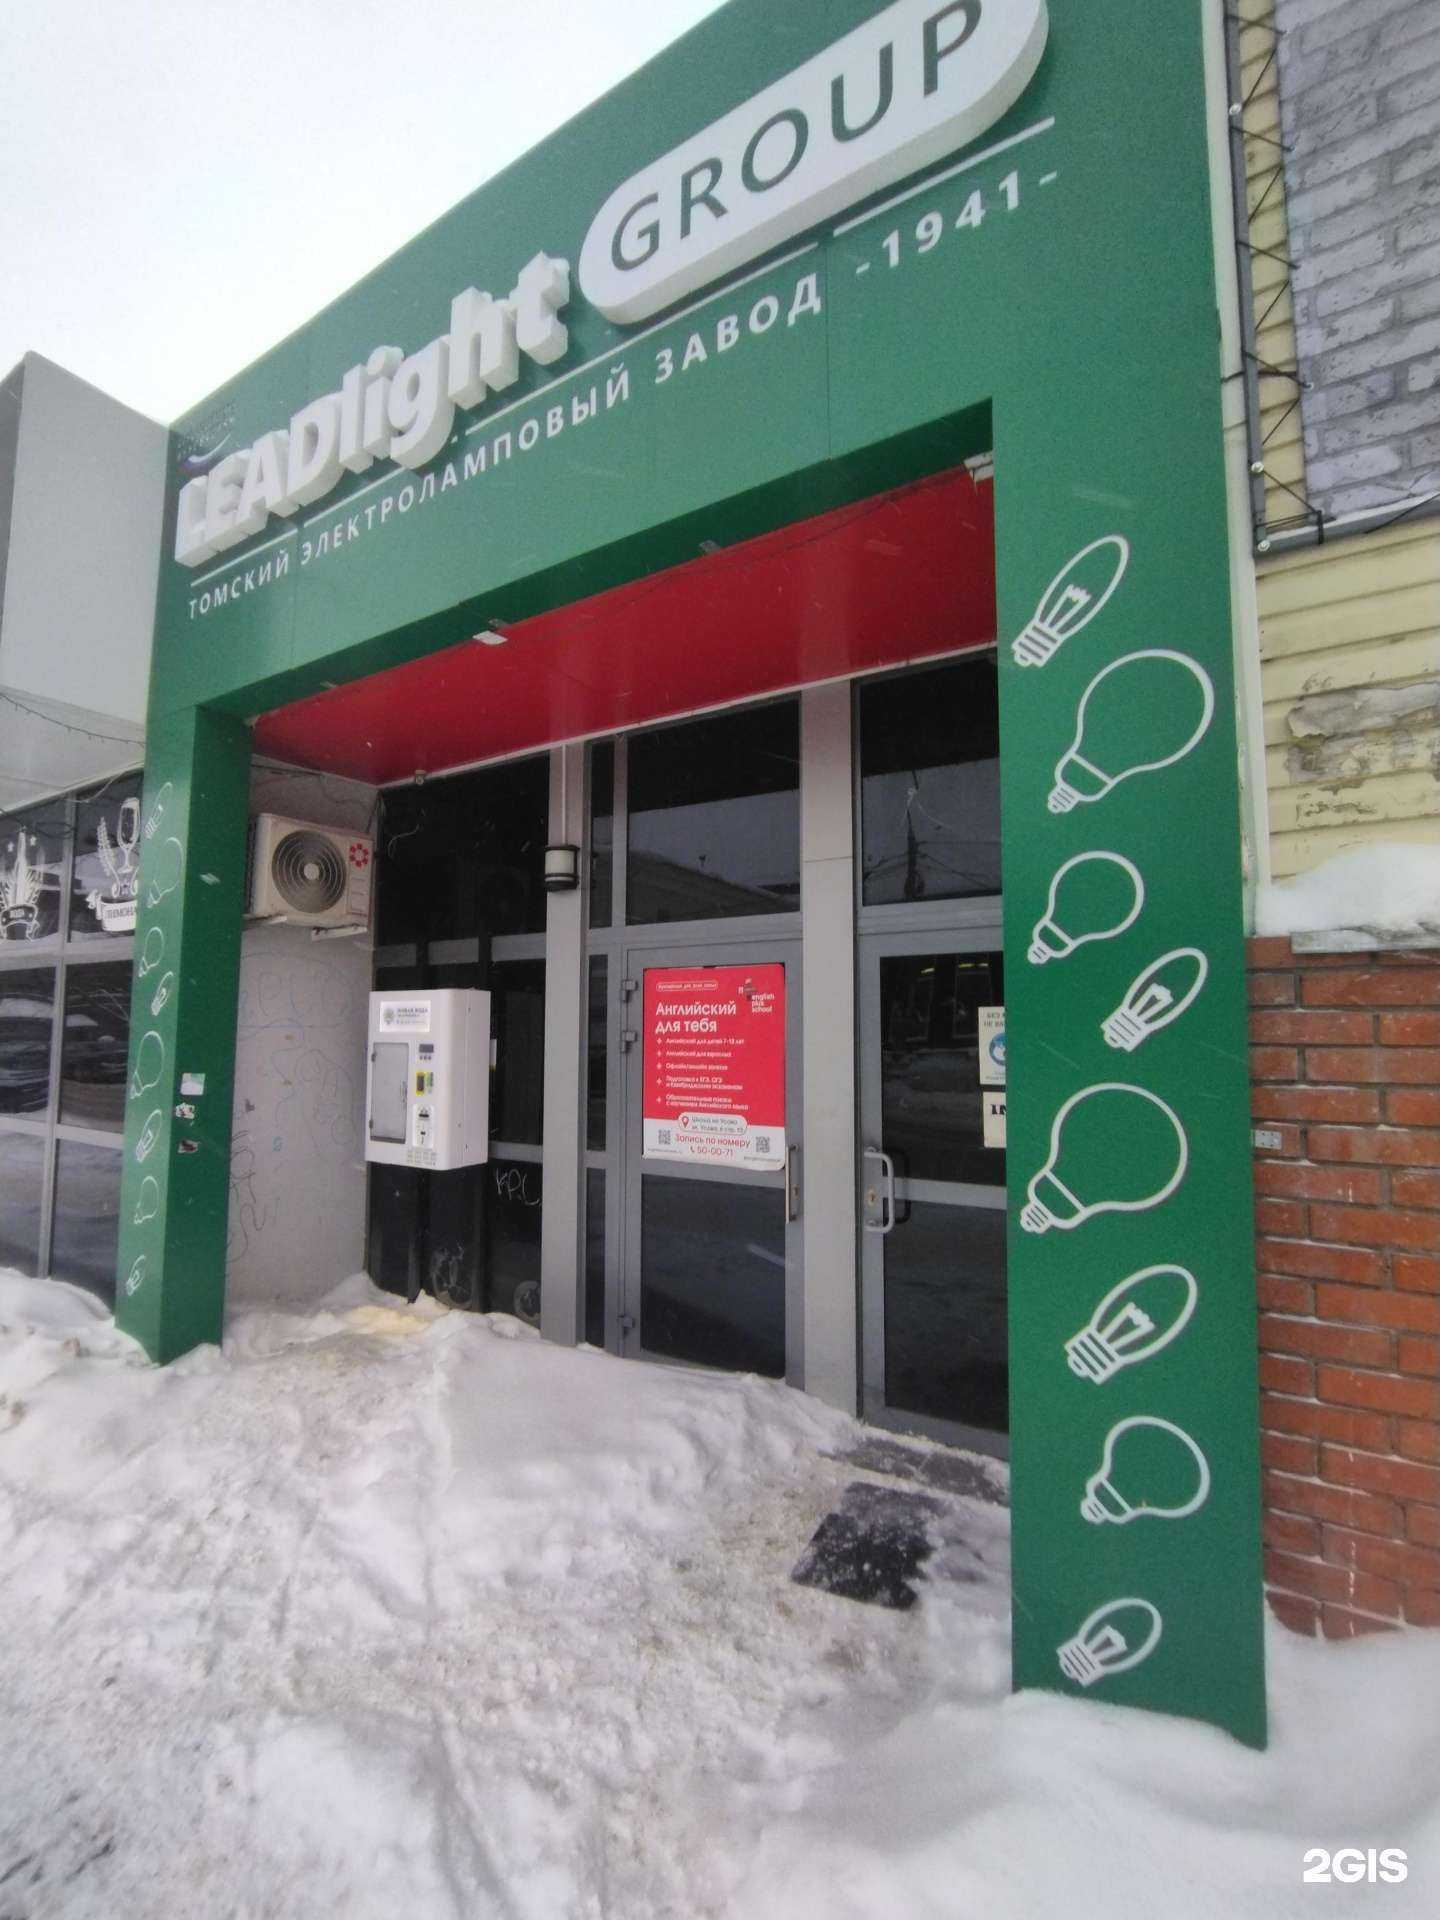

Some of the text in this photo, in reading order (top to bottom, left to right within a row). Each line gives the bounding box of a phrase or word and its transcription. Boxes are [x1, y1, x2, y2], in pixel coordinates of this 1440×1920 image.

[175, 0, 983, 568] LEADlight GROUP
[187, 549, 290, 621] ТОМСКИЙ
[301, 362, 630, 566] ЭЛЕКТРОЛАМПОВЫЙ
[654, 272, 822, 385] ЗАВОД
[655, 1001, 737, 1016] Английский
[655, 1017, 717, 1035] для тебя
[675, 1133, 751, 1149] Запись по номеру
[697, 1145, 734, 1156] 50-00-71
